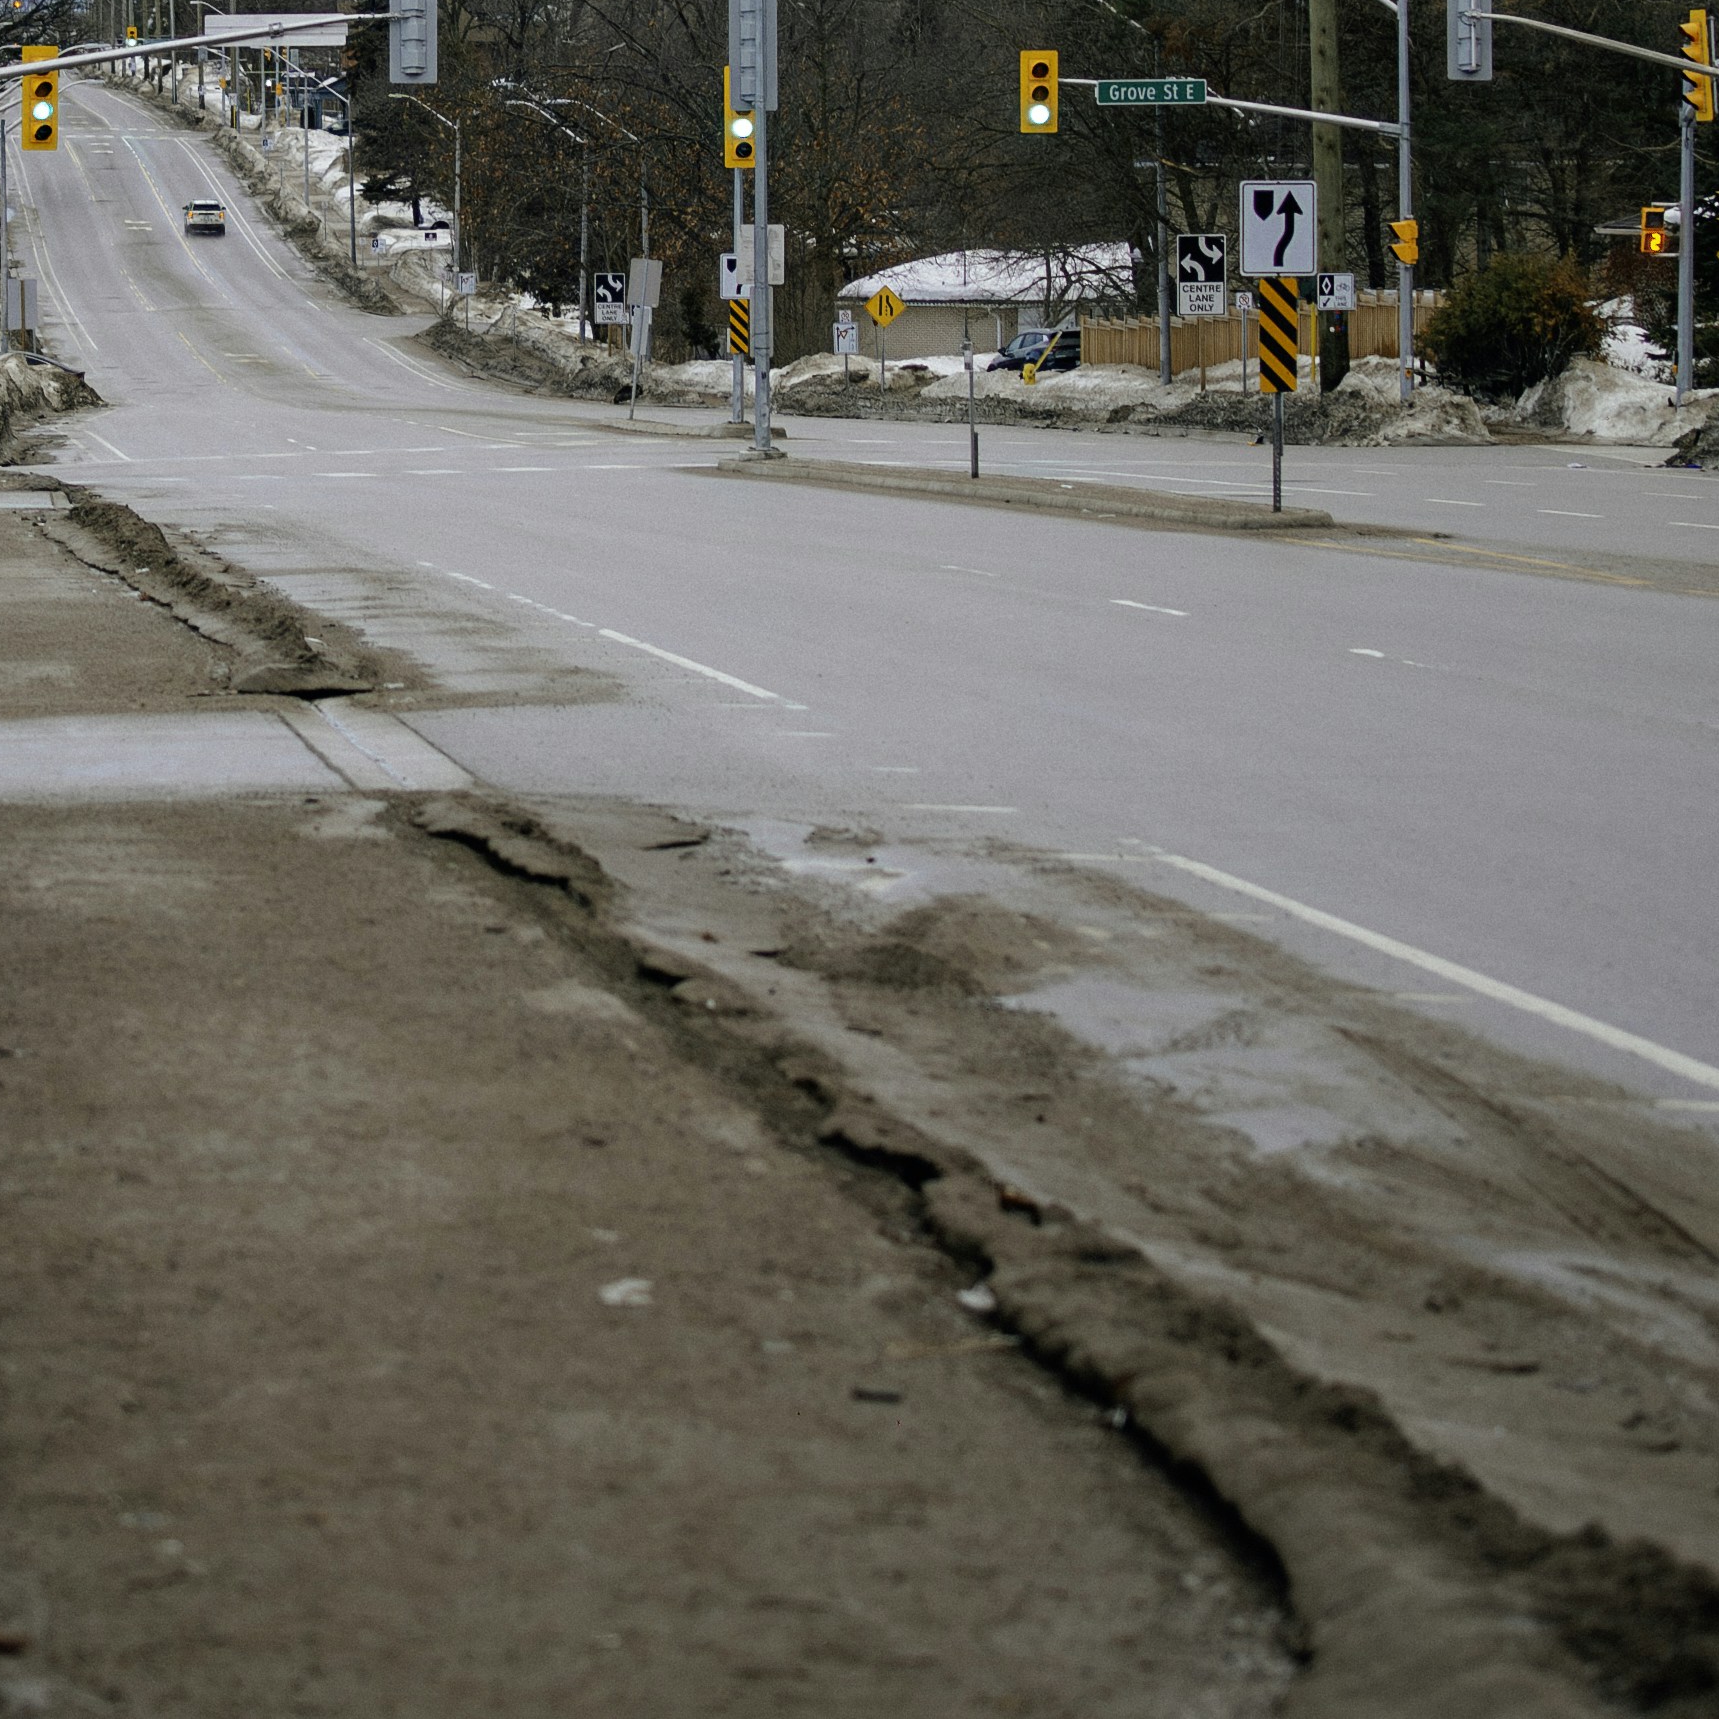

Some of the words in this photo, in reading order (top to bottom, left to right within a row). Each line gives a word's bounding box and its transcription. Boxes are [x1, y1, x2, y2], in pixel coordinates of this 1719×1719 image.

[1109, 85, 1156, 100] Grove
[1164, 84, 1178, 99] St
[1186, 84, 1194, 99] E
[1182, 284, 1221, 293] CENTRE
[1189, 294, 1215, 302] LANE
[1189, 303, 1214, 312] ONLY
